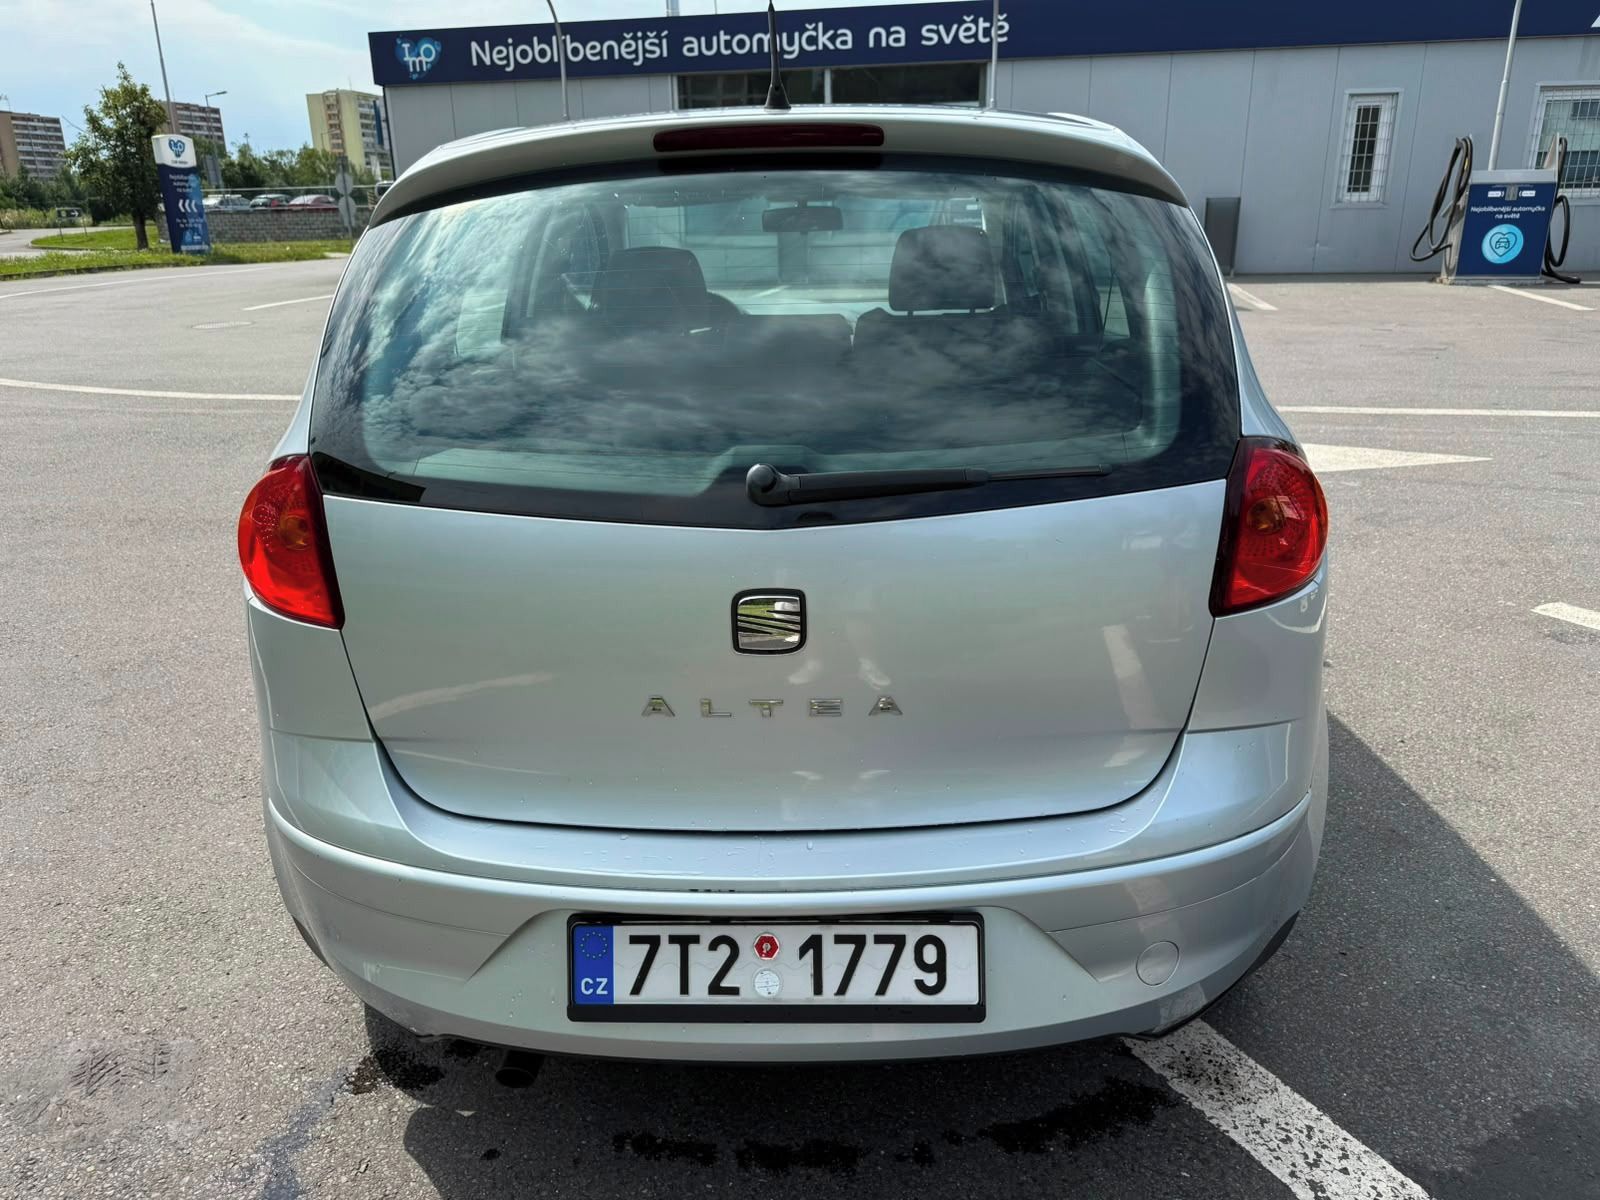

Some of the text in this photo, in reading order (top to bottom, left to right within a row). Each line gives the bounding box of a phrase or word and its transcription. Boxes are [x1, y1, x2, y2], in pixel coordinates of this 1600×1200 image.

[470, 13, 1009, 71] Nejoblbenější automyčka na světě
[641, 695, 903, 717] ALTEA
[628, 934, 741, 996] 7T2
[798, 934, 947, 996] 1779
[581, 977, 608, 995] CZ
